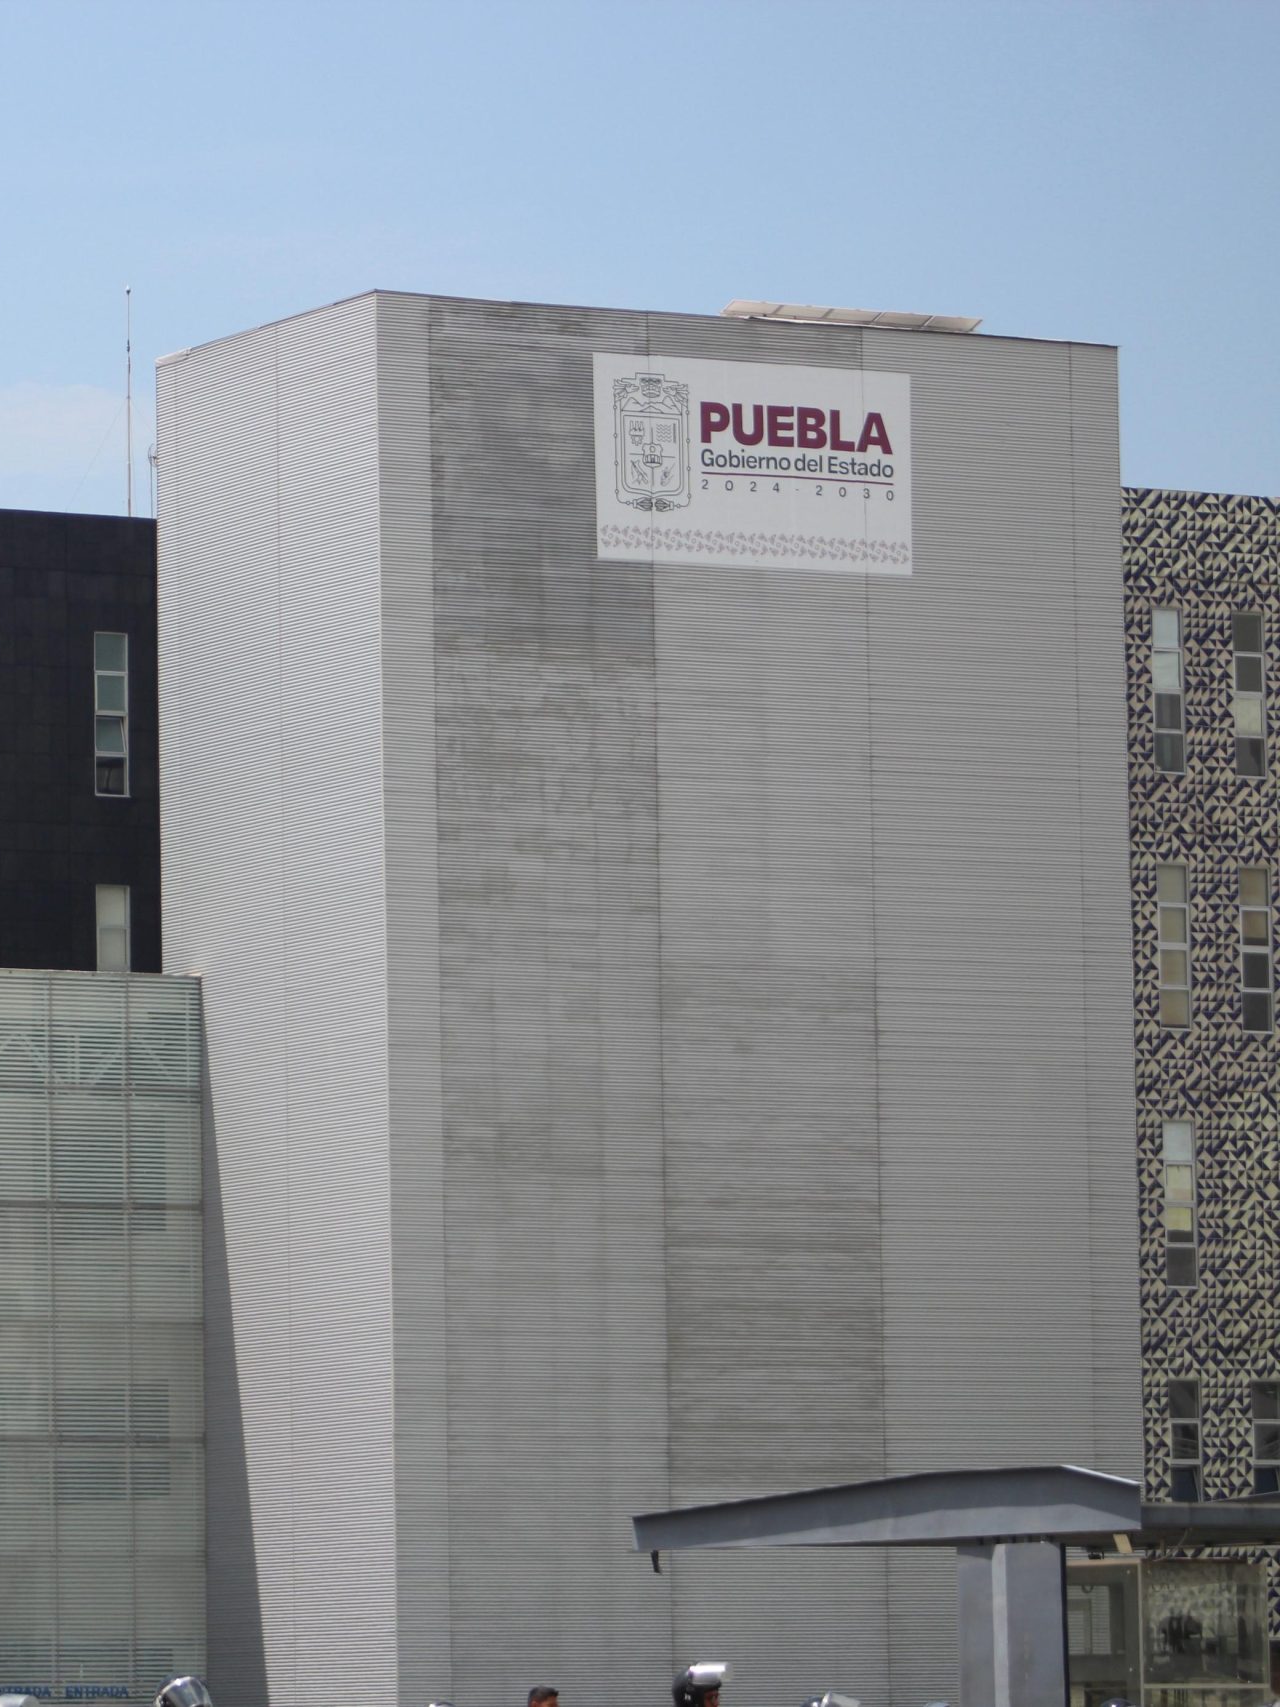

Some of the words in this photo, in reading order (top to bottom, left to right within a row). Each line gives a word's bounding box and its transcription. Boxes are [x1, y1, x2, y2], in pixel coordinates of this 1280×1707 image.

[700, 401, 894, 455] PUEBLA
[701, 449, 791, 471] Gobierno
[794, 453, 823, 473] del
[828, 456, 894, 478] Estado
[65, 1685, 129, 1698] ENTRADA
